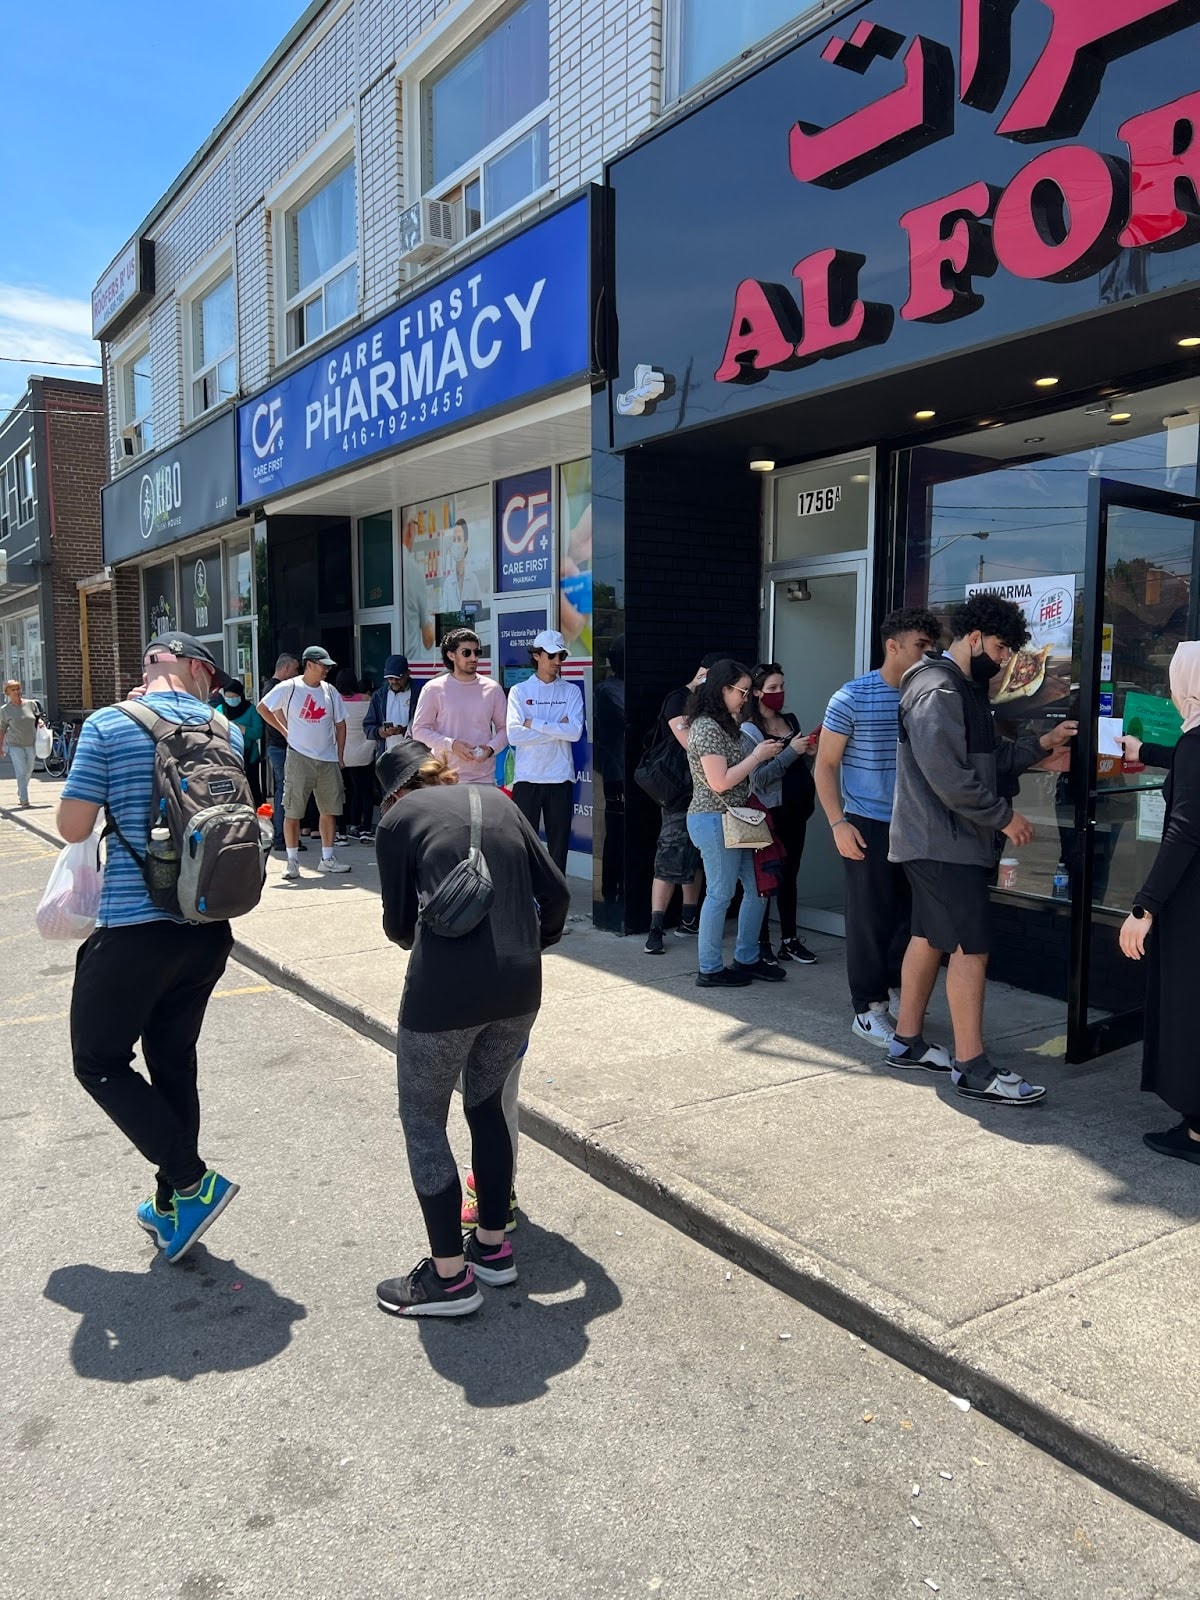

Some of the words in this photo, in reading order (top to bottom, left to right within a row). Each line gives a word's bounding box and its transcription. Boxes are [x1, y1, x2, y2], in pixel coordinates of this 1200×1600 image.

[714, 248, 884, 383] AL
[328, 332, 383, 385] CARE
[400, 274, 482, 347] FIRST
[305, 278, 546, 450] PHARMACY
[342, 386, 463, 453] 416-792-3455
[253, 463, 268, 478] CARE
[268, 457, 284, 473] FIRST
[503, 562, 524, 575] CARE
[525, 558, 548, 572] FIRST
[512, 575, 537, 584] PHARMACY
[1039, 599, 1063, 623] FREE
[527, 628, 537, 636] Park
[577, 771, 592, 783] ALL
[574, 804, 593, 817] FAST
